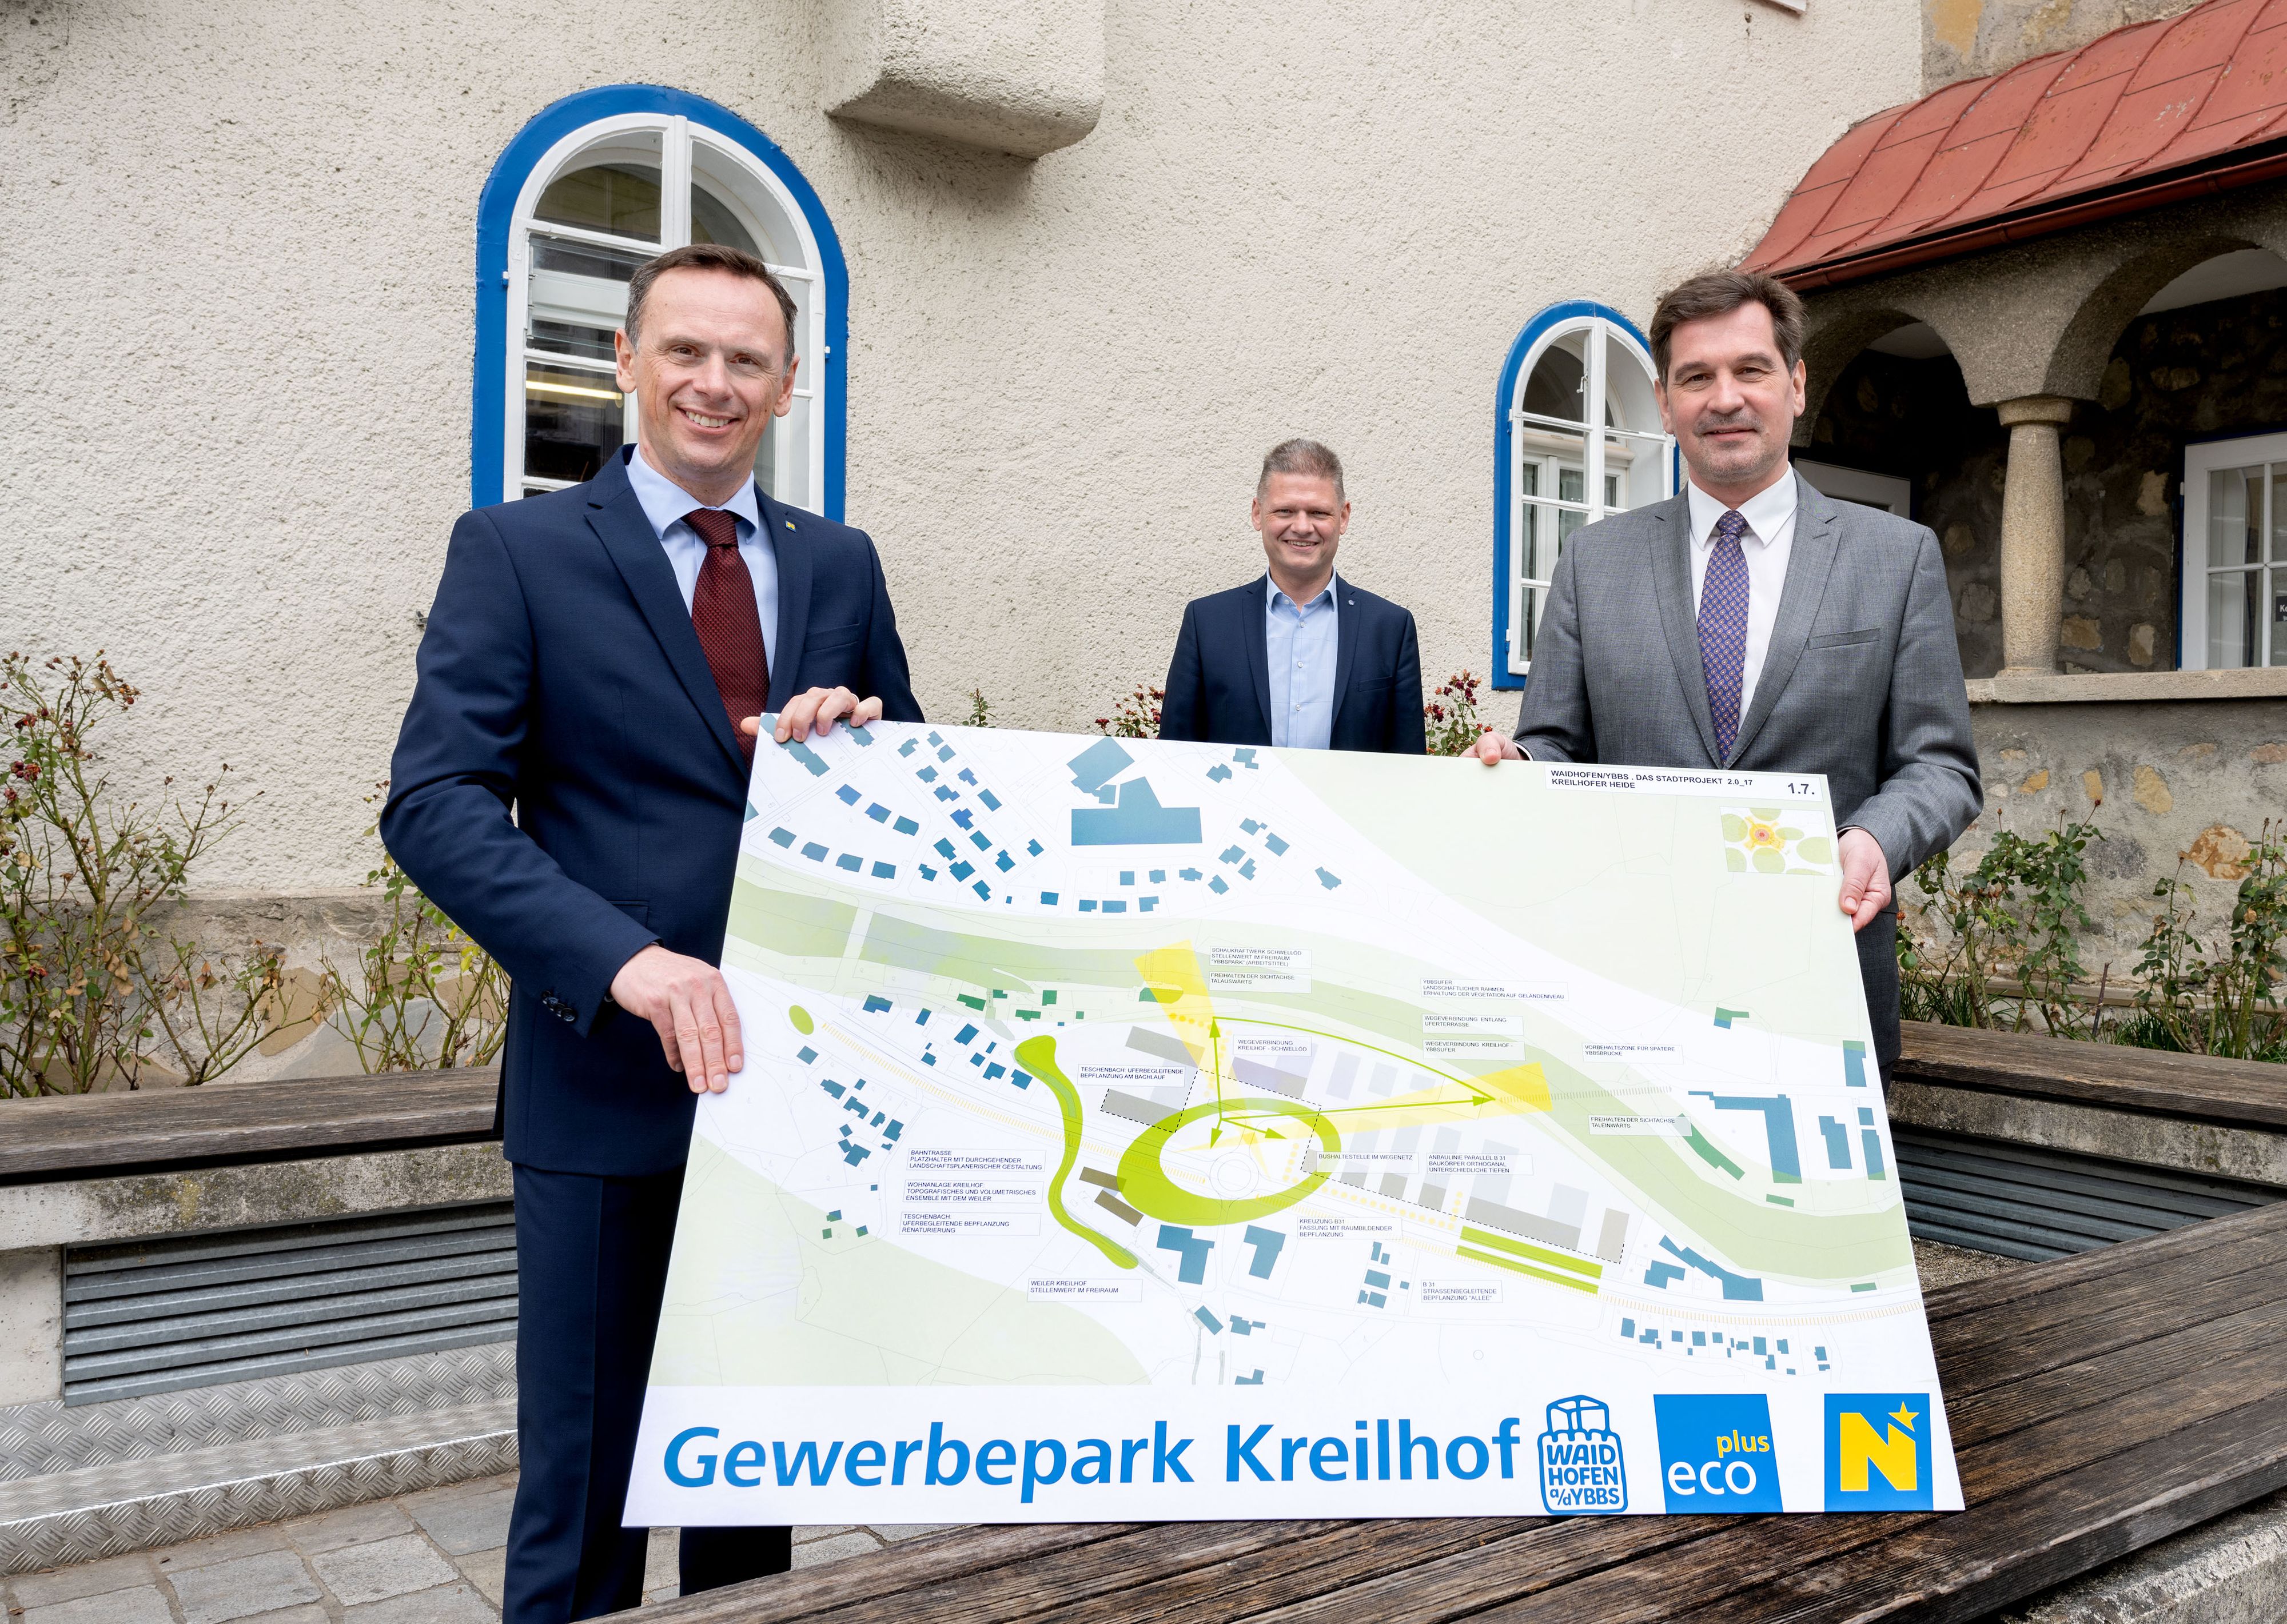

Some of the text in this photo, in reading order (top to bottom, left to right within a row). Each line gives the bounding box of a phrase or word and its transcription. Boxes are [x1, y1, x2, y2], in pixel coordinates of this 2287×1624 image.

[1551, 770, 1629, 780] WAIDHOFEN/YBBS
[1656, 775, 1723, 784] STADTPROJEKT
[1727, 778, 1753, 787] 2.0_17
[1552, 779, 1607, 788] KREILHOFER
[1787, 783, 1815, 795] 1.7.
[1716, 1430, 1770, 1458] plus
[663, 1417, 1521, 1503] Gewerbepark Kreilhof
[1547, 1444, 1615, 1466] WAID
[1548, 1467, 1619, 1486] HOFEN
[1668, 1460, 1757, 1495] eco
